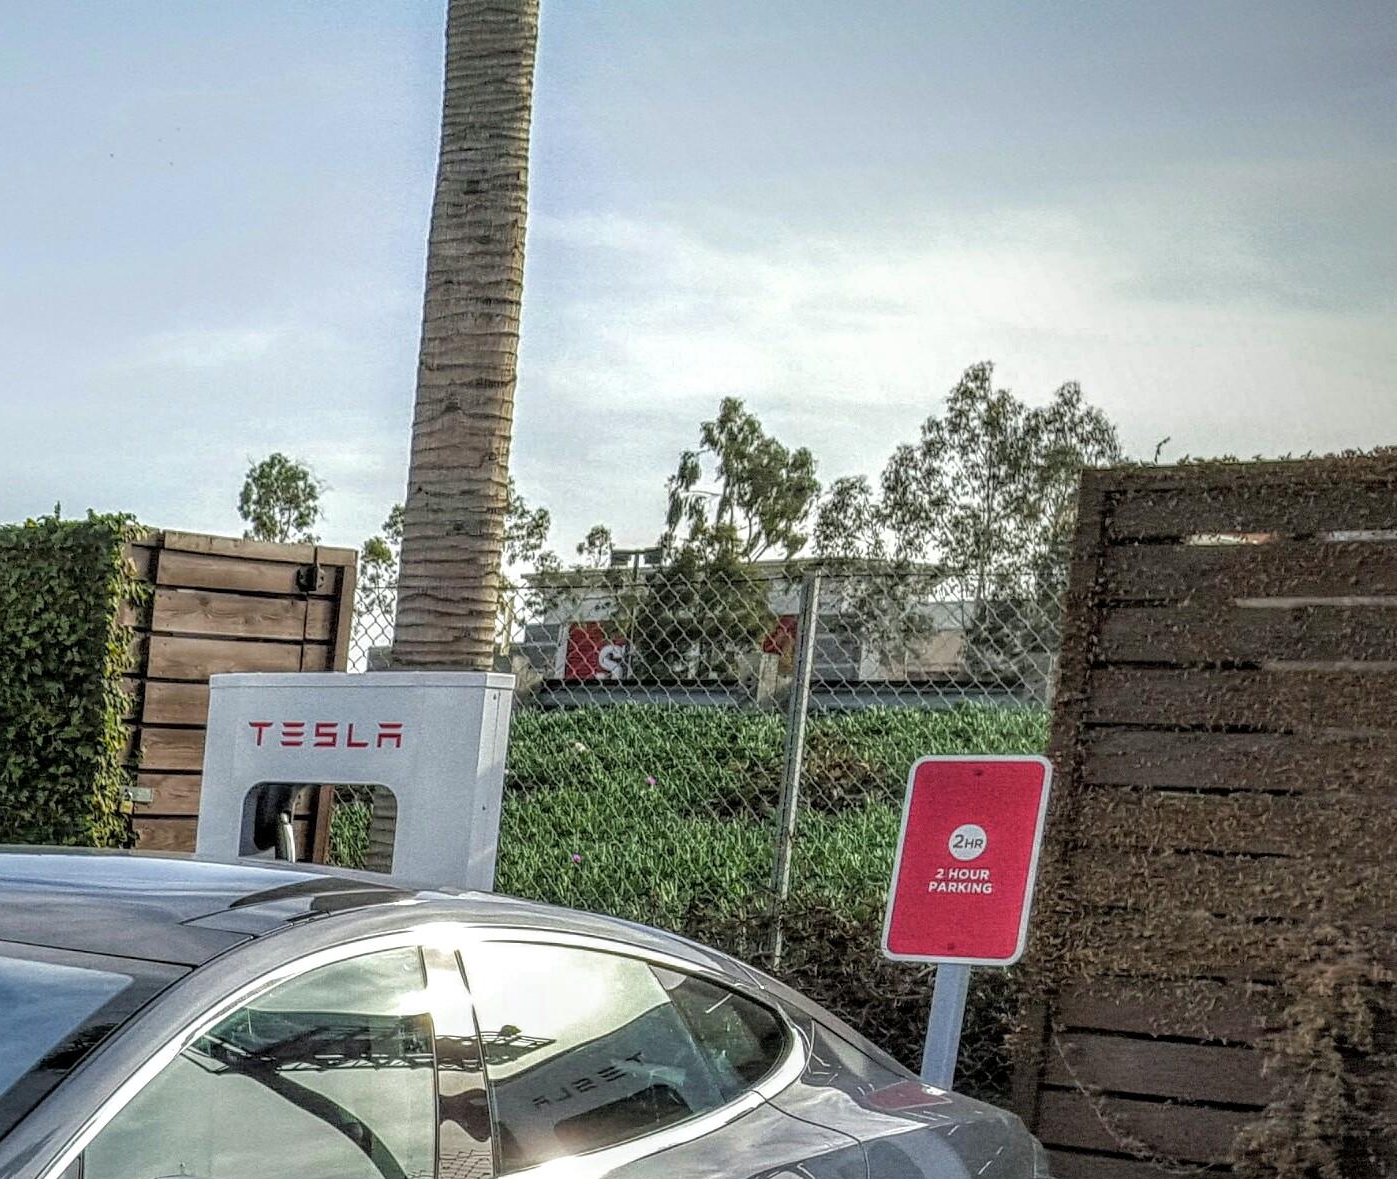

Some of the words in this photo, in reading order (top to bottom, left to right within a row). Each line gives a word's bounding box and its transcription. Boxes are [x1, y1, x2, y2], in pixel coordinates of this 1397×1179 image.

[248, 721, 404, 749] TESLA
[952, 834, 984, 849] 2HR
[935, 868, 945, 879] 2
[948, 868, 990, 880] HOUR
[928, 881, 993, 894] PARKING
